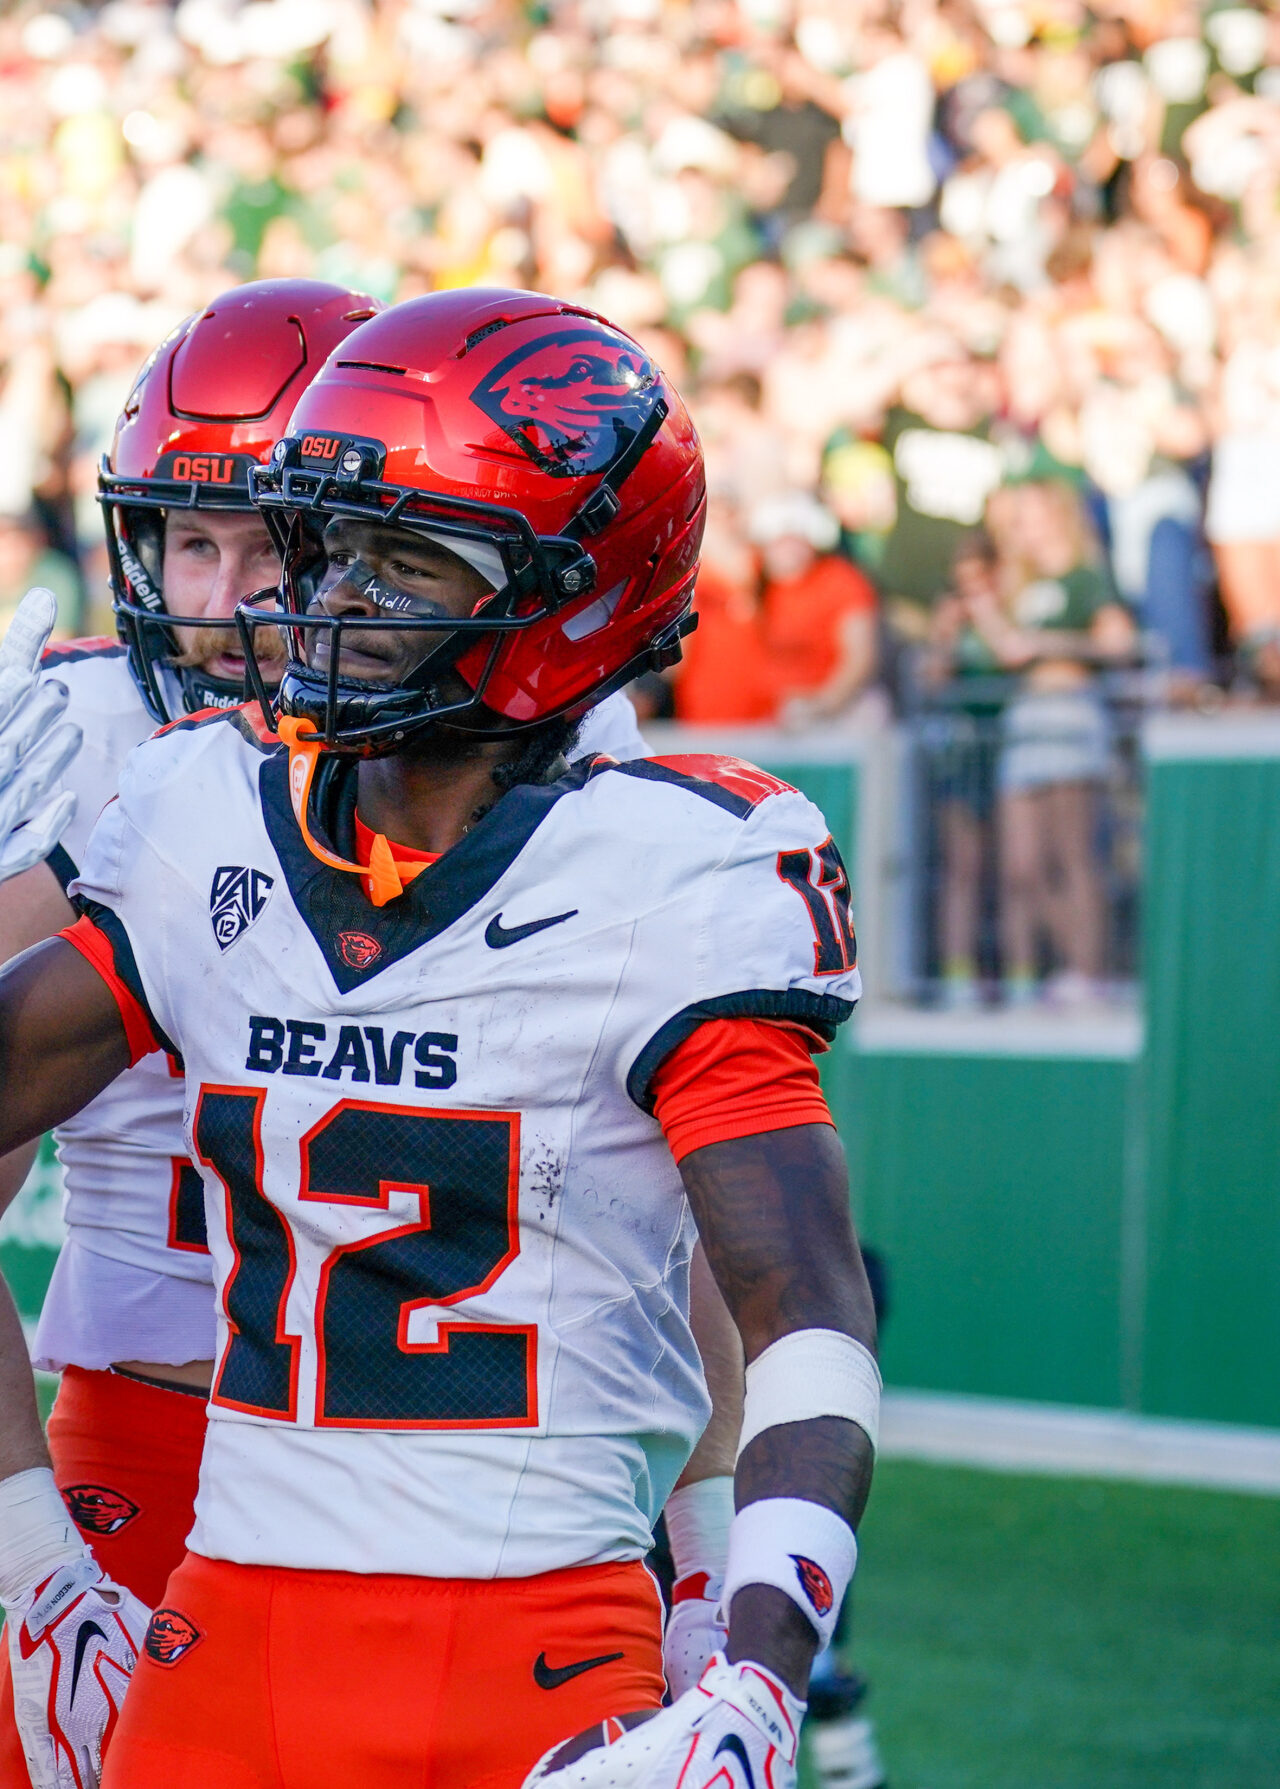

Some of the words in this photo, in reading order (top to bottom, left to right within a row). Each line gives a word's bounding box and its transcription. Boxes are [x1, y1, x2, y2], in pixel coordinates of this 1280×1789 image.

[173, 456, 235, 484] OSU
[300, 435, 340, 460] OSU
[210, 866, 274, 921] PAC
[776, 834, 859, 977] 12
[218, 919, 236, 937] 12
[245, 1015, 459, 1090] BEAVS
[193, 1082, 539, 1430] 12
